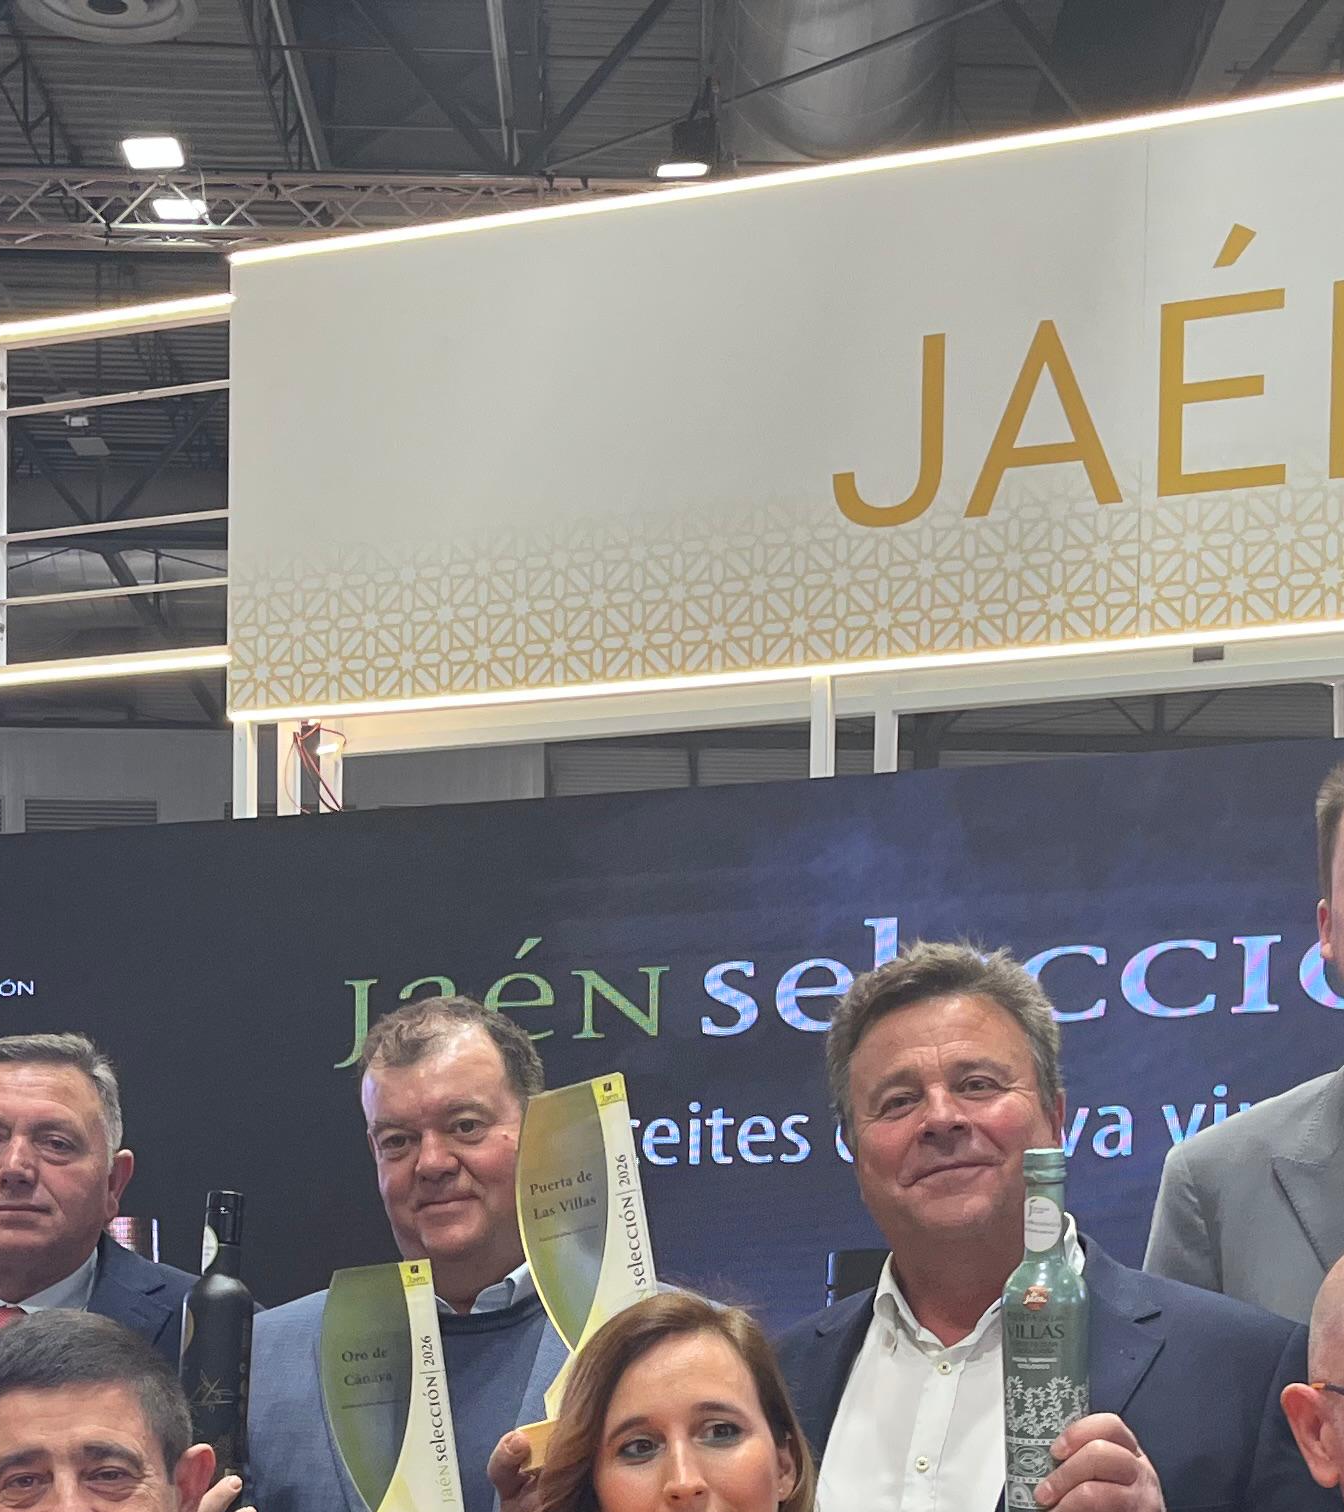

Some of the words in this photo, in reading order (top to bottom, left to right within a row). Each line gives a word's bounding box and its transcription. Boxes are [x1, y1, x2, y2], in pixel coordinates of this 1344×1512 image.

[530, 1177, 573, 1196] Puerta
[577, 1170, 592, 1184] de
[616, 1154, 630, 1186] 2026
[533, 1207, 556, 1220] Las
[559, 1195, 597, 1212] Villas
[342, 1350, 368, 1362] Oro
[373, 1347, 387, 1358] de
[421, 1335, 434, 1366] 2026
